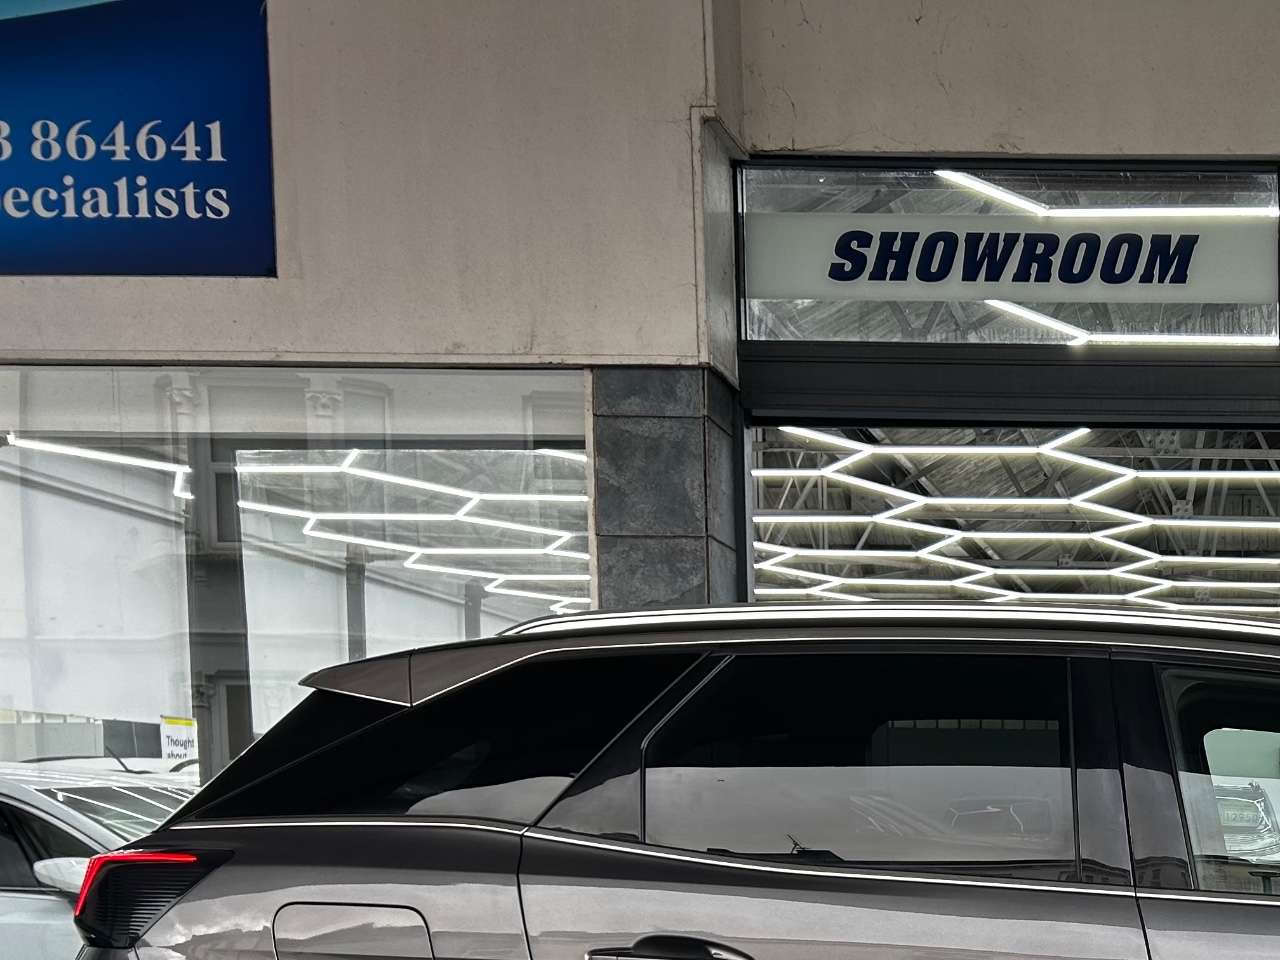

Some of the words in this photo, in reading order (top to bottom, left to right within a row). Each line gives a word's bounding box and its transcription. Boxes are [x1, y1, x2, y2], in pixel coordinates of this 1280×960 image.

[31, 120, 227, 161] 864641
[828, 230, 1199, 284] SHOWROOM
[166, 735, 194, 749] Thought
